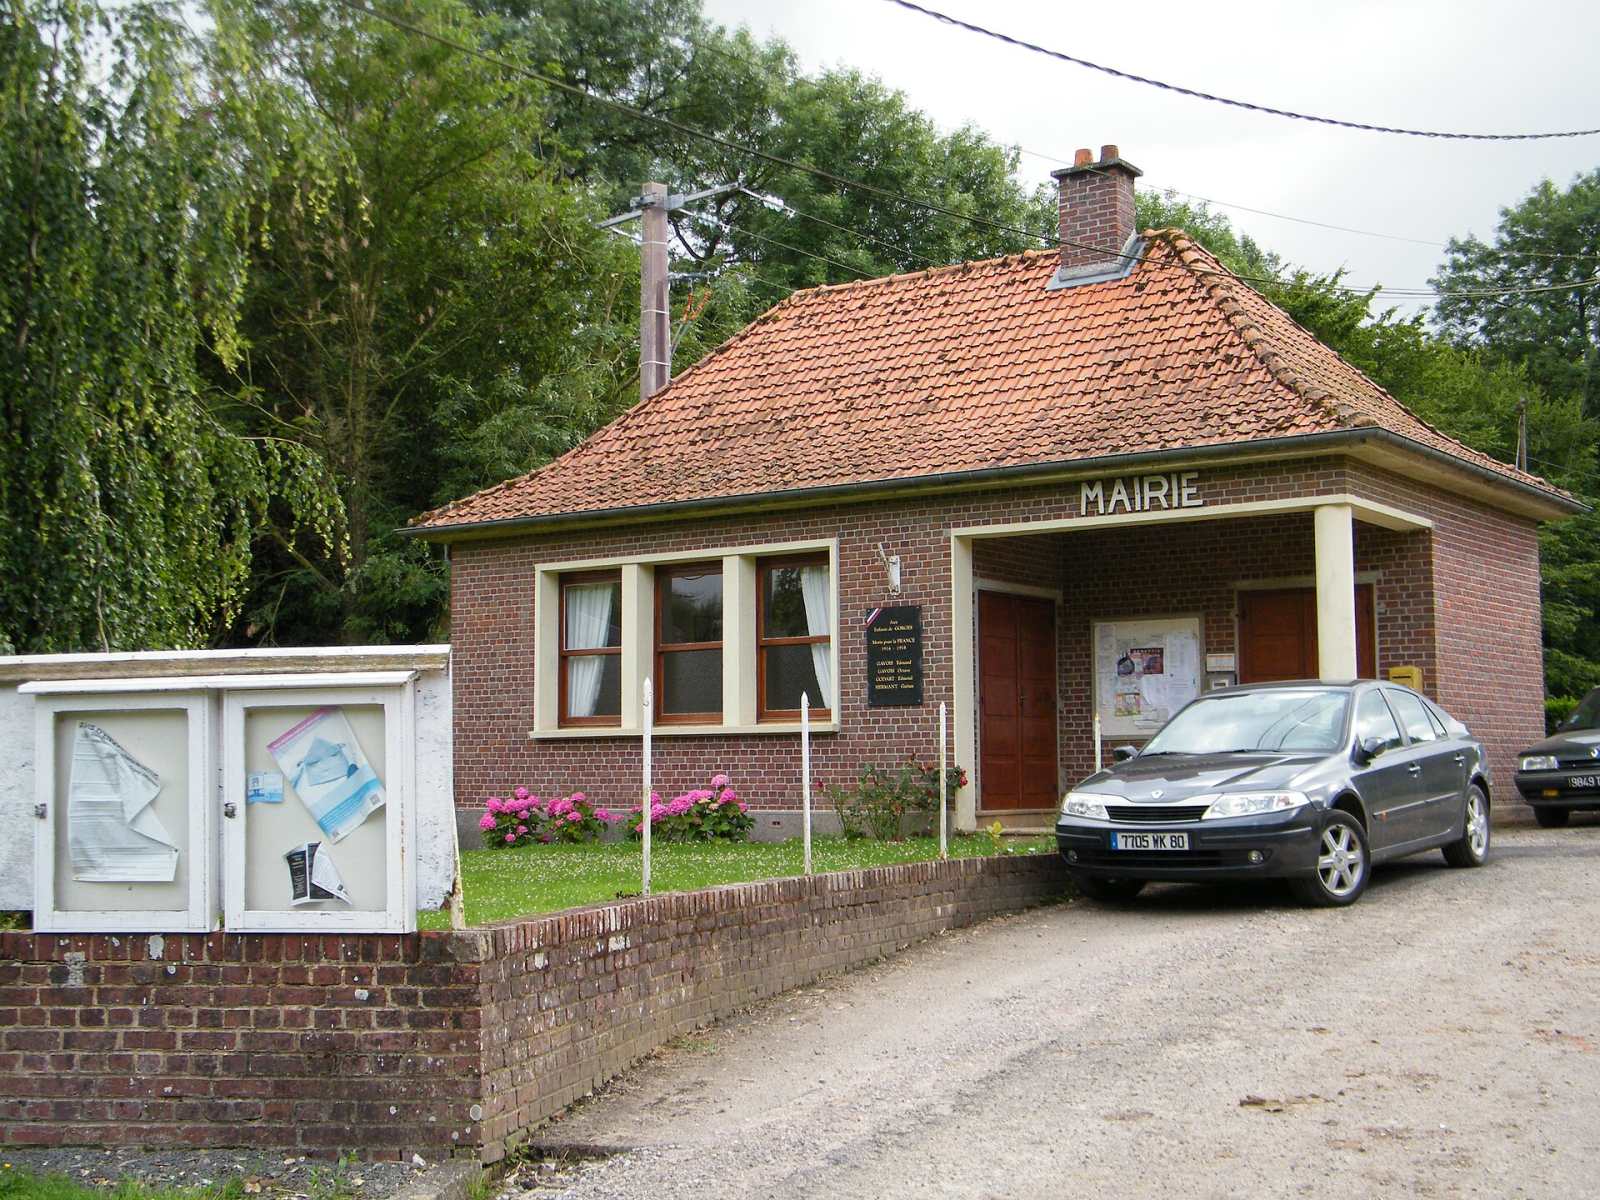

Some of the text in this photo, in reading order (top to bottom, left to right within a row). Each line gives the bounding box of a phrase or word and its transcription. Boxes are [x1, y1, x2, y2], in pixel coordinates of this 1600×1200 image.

[1080, 472, 1203, 516] MAIRIE
[1121, 834, 1185, 849] 7705 WK 80
